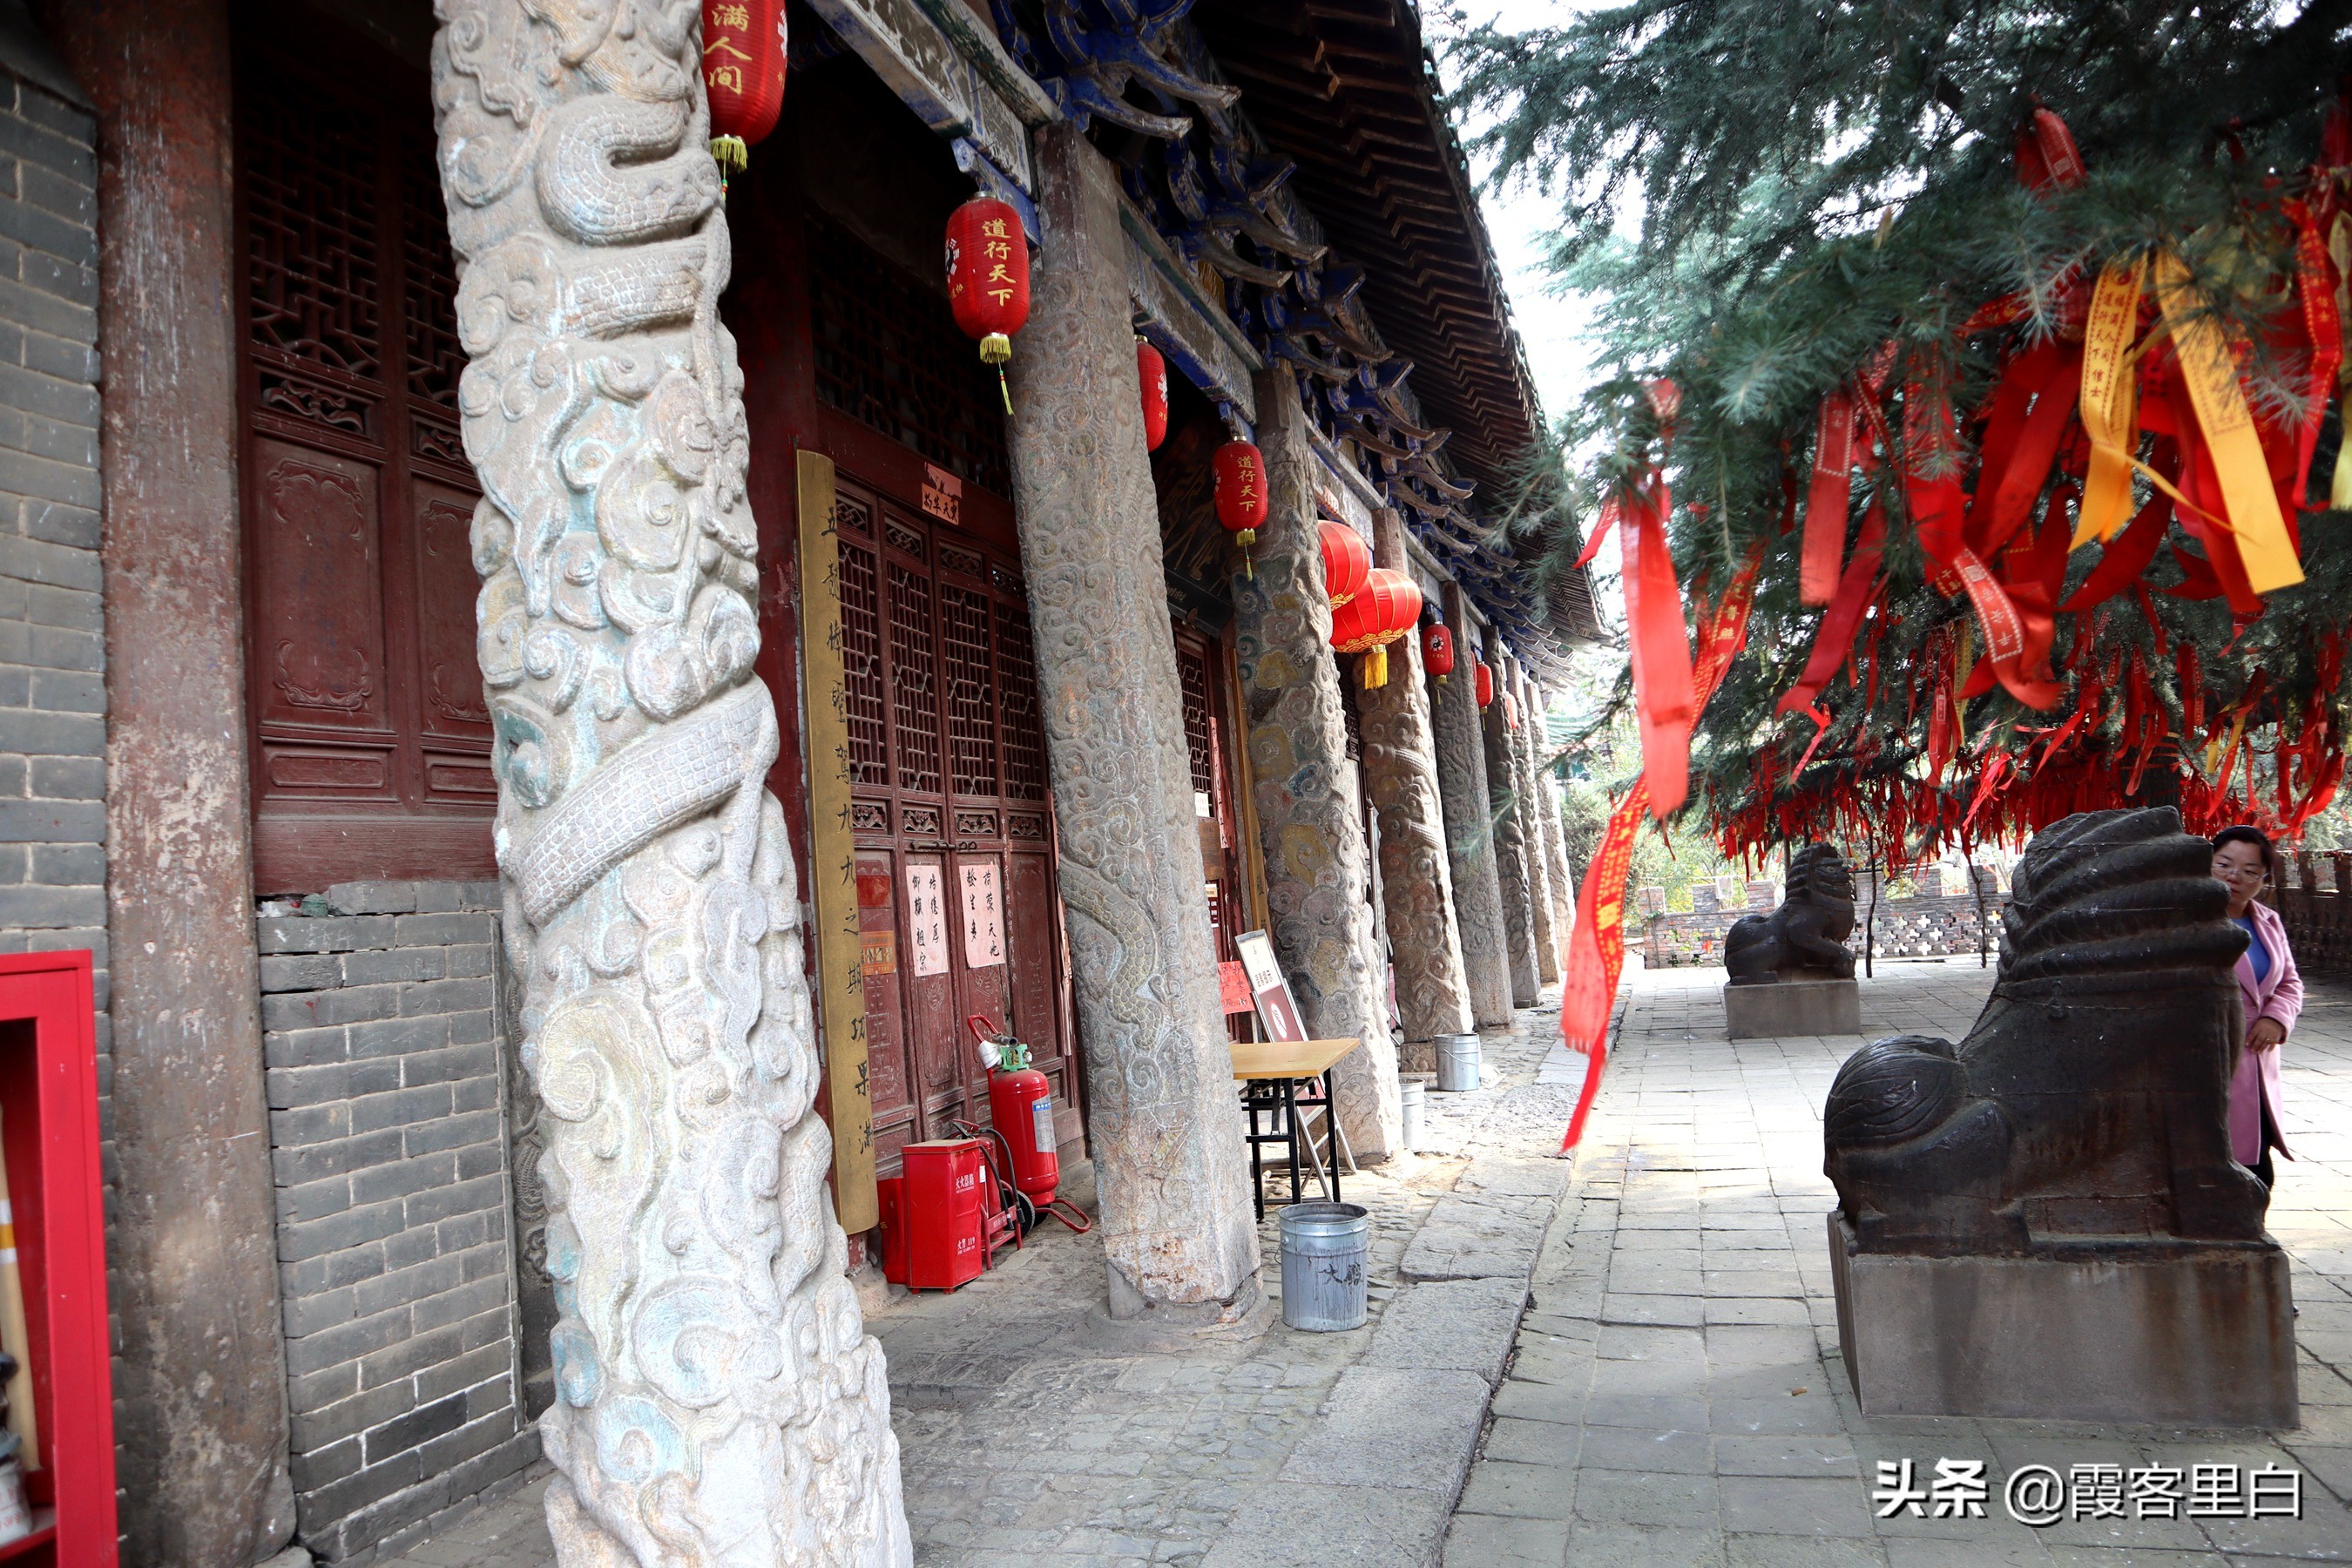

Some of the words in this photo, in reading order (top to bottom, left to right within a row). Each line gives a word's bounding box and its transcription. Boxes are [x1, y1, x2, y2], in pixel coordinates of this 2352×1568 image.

[982, 218, 1017, 307] 道行天下
[1237, 454, 1259, 512] 道行天下
